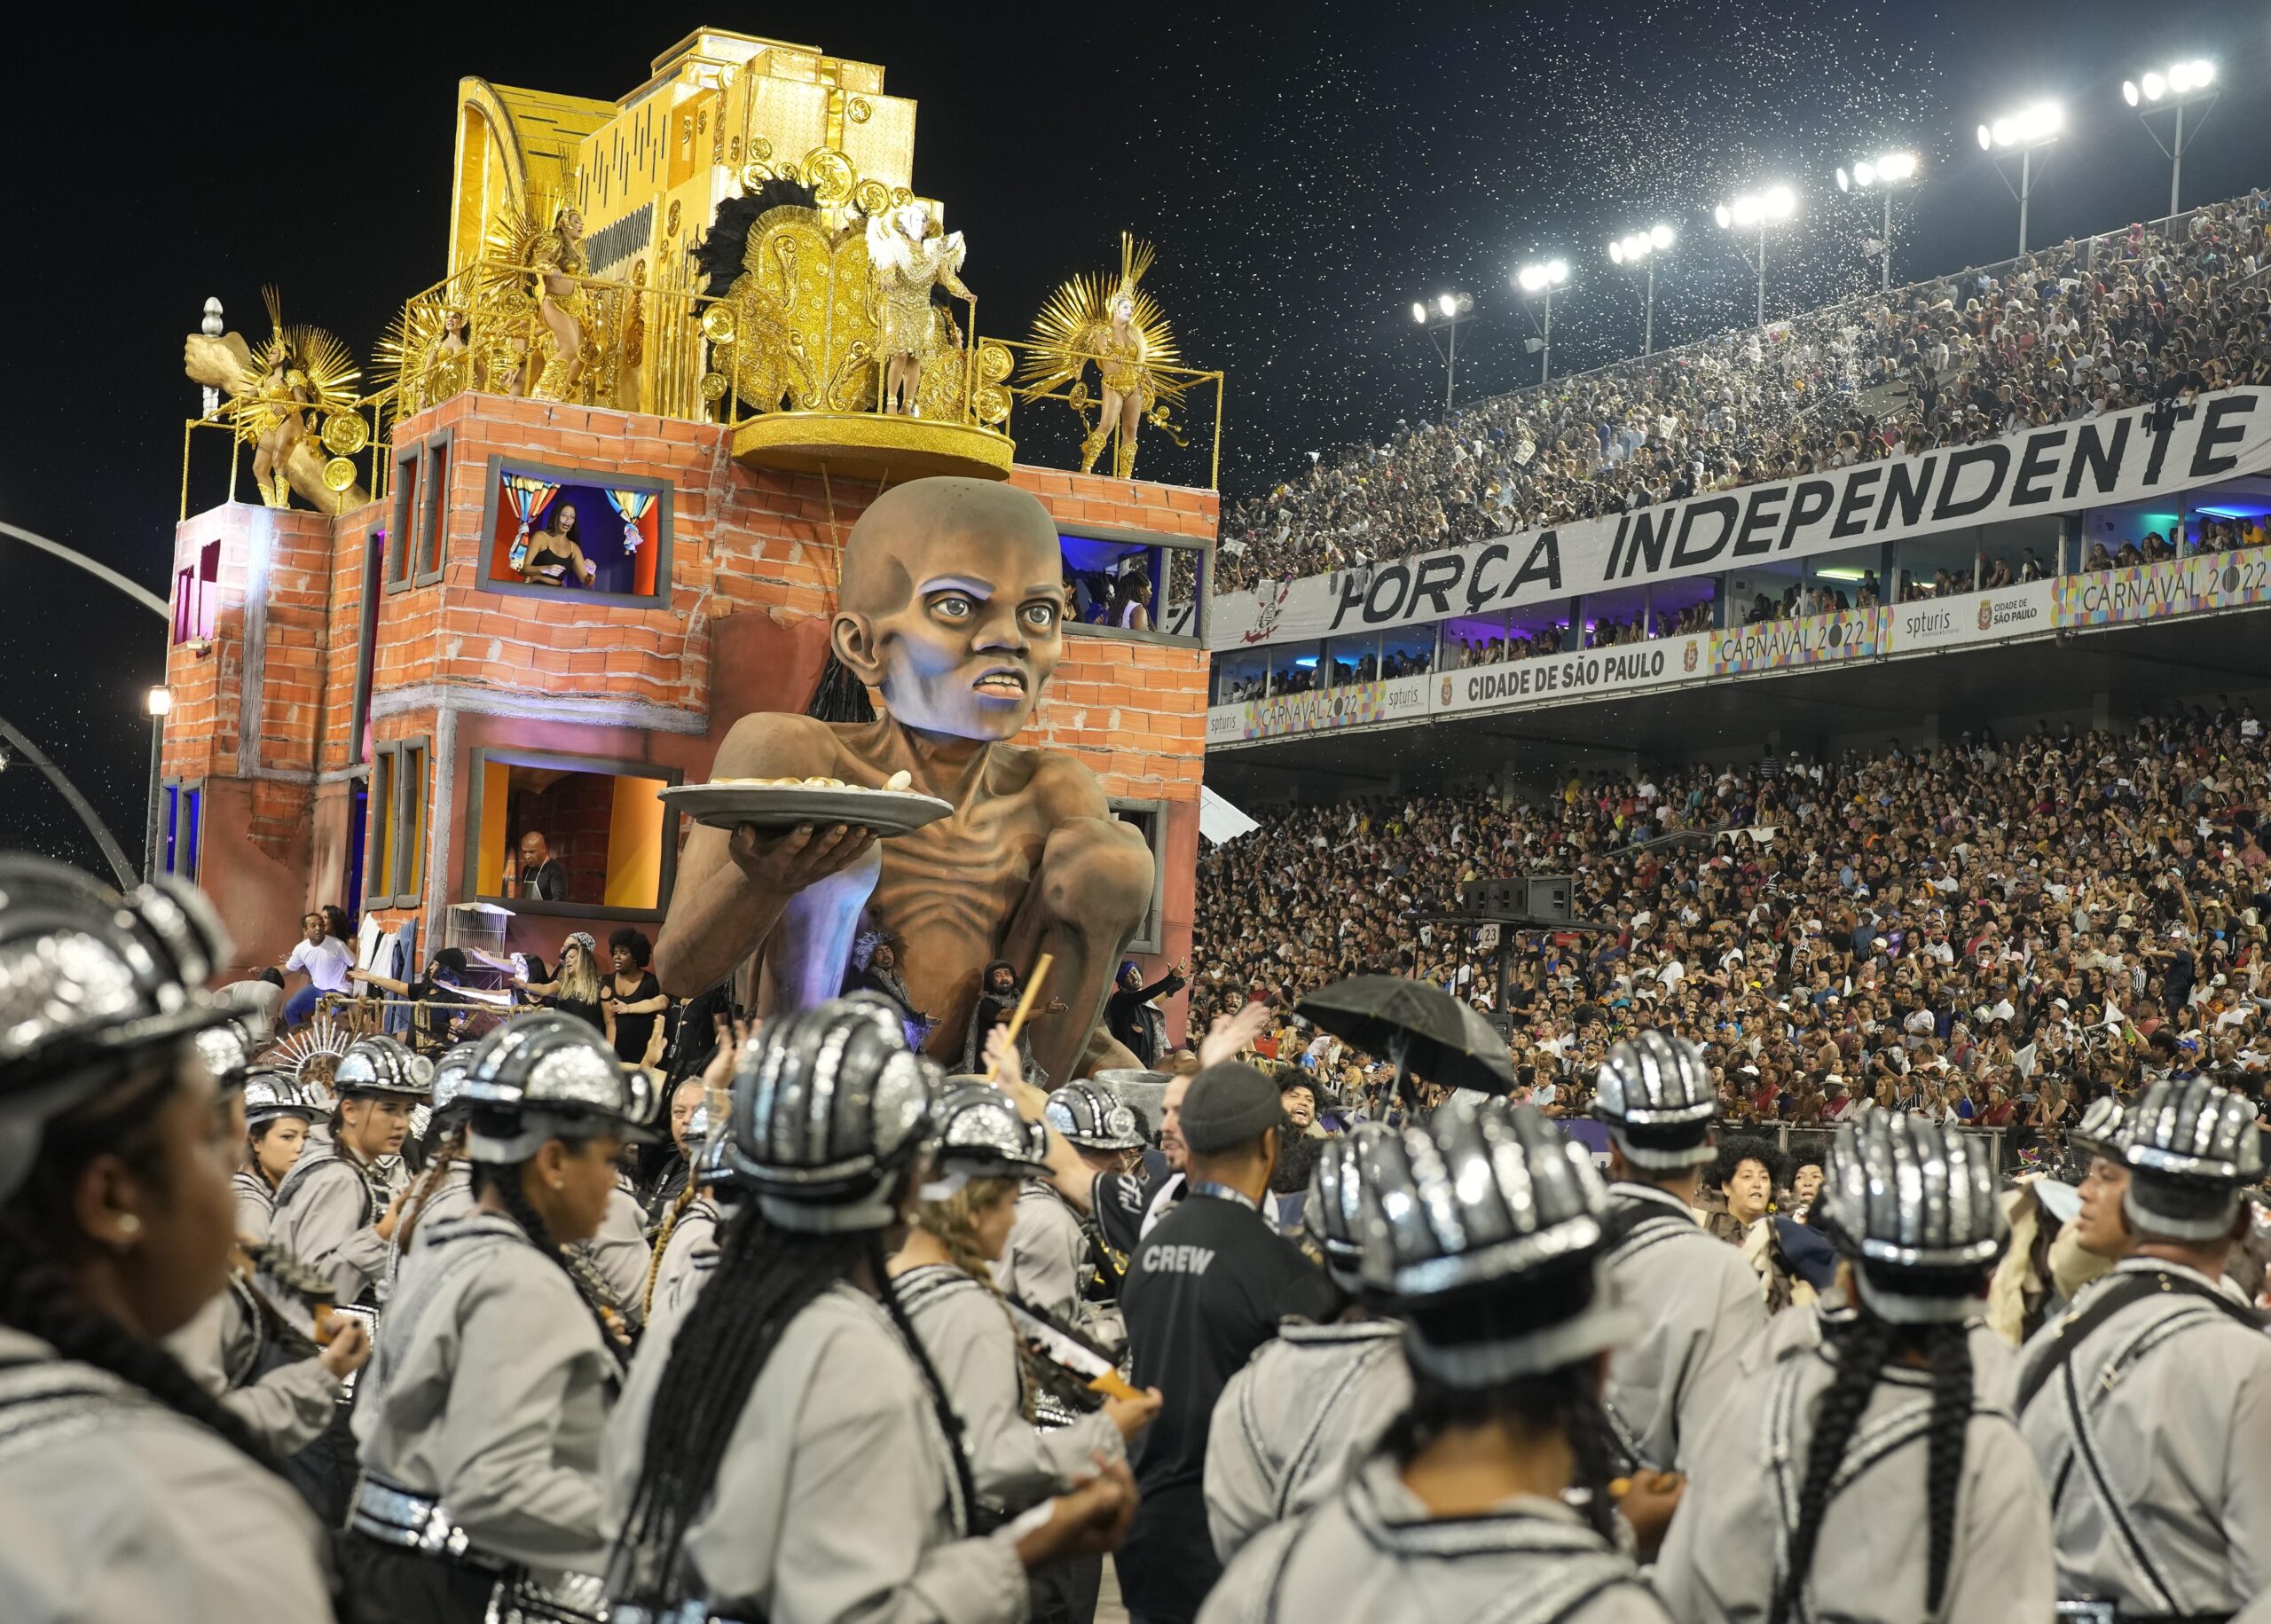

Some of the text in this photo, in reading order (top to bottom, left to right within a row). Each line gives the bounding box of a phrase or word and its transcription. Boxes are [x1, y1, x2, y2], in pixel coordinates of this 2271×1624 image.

[1604, 395, 2259, 581] INDEPENDENTE
[2083, 561, 2267, 612] CARNAVAL 2022
[1993, 608, 2037, 624] SÃO PAULO
[1994, 599, 2028, 612] CIDADE DE
[1906, 608, 1950, 639] spturis
[1722, 621, 1863, 663] CARNAVAL 2022
[1468, 650, 1664, 702] CIDADE DE SÃO PAULO
[1261, 694, 1357, 726] CARNAVAL 2022
[1389, 685, 1418, 710] spturis
[1211, 712, 1236, 734] spturis
[1485, 928, 1497, 942] 23
[1142, 1244, 1215, 1275] CREW
